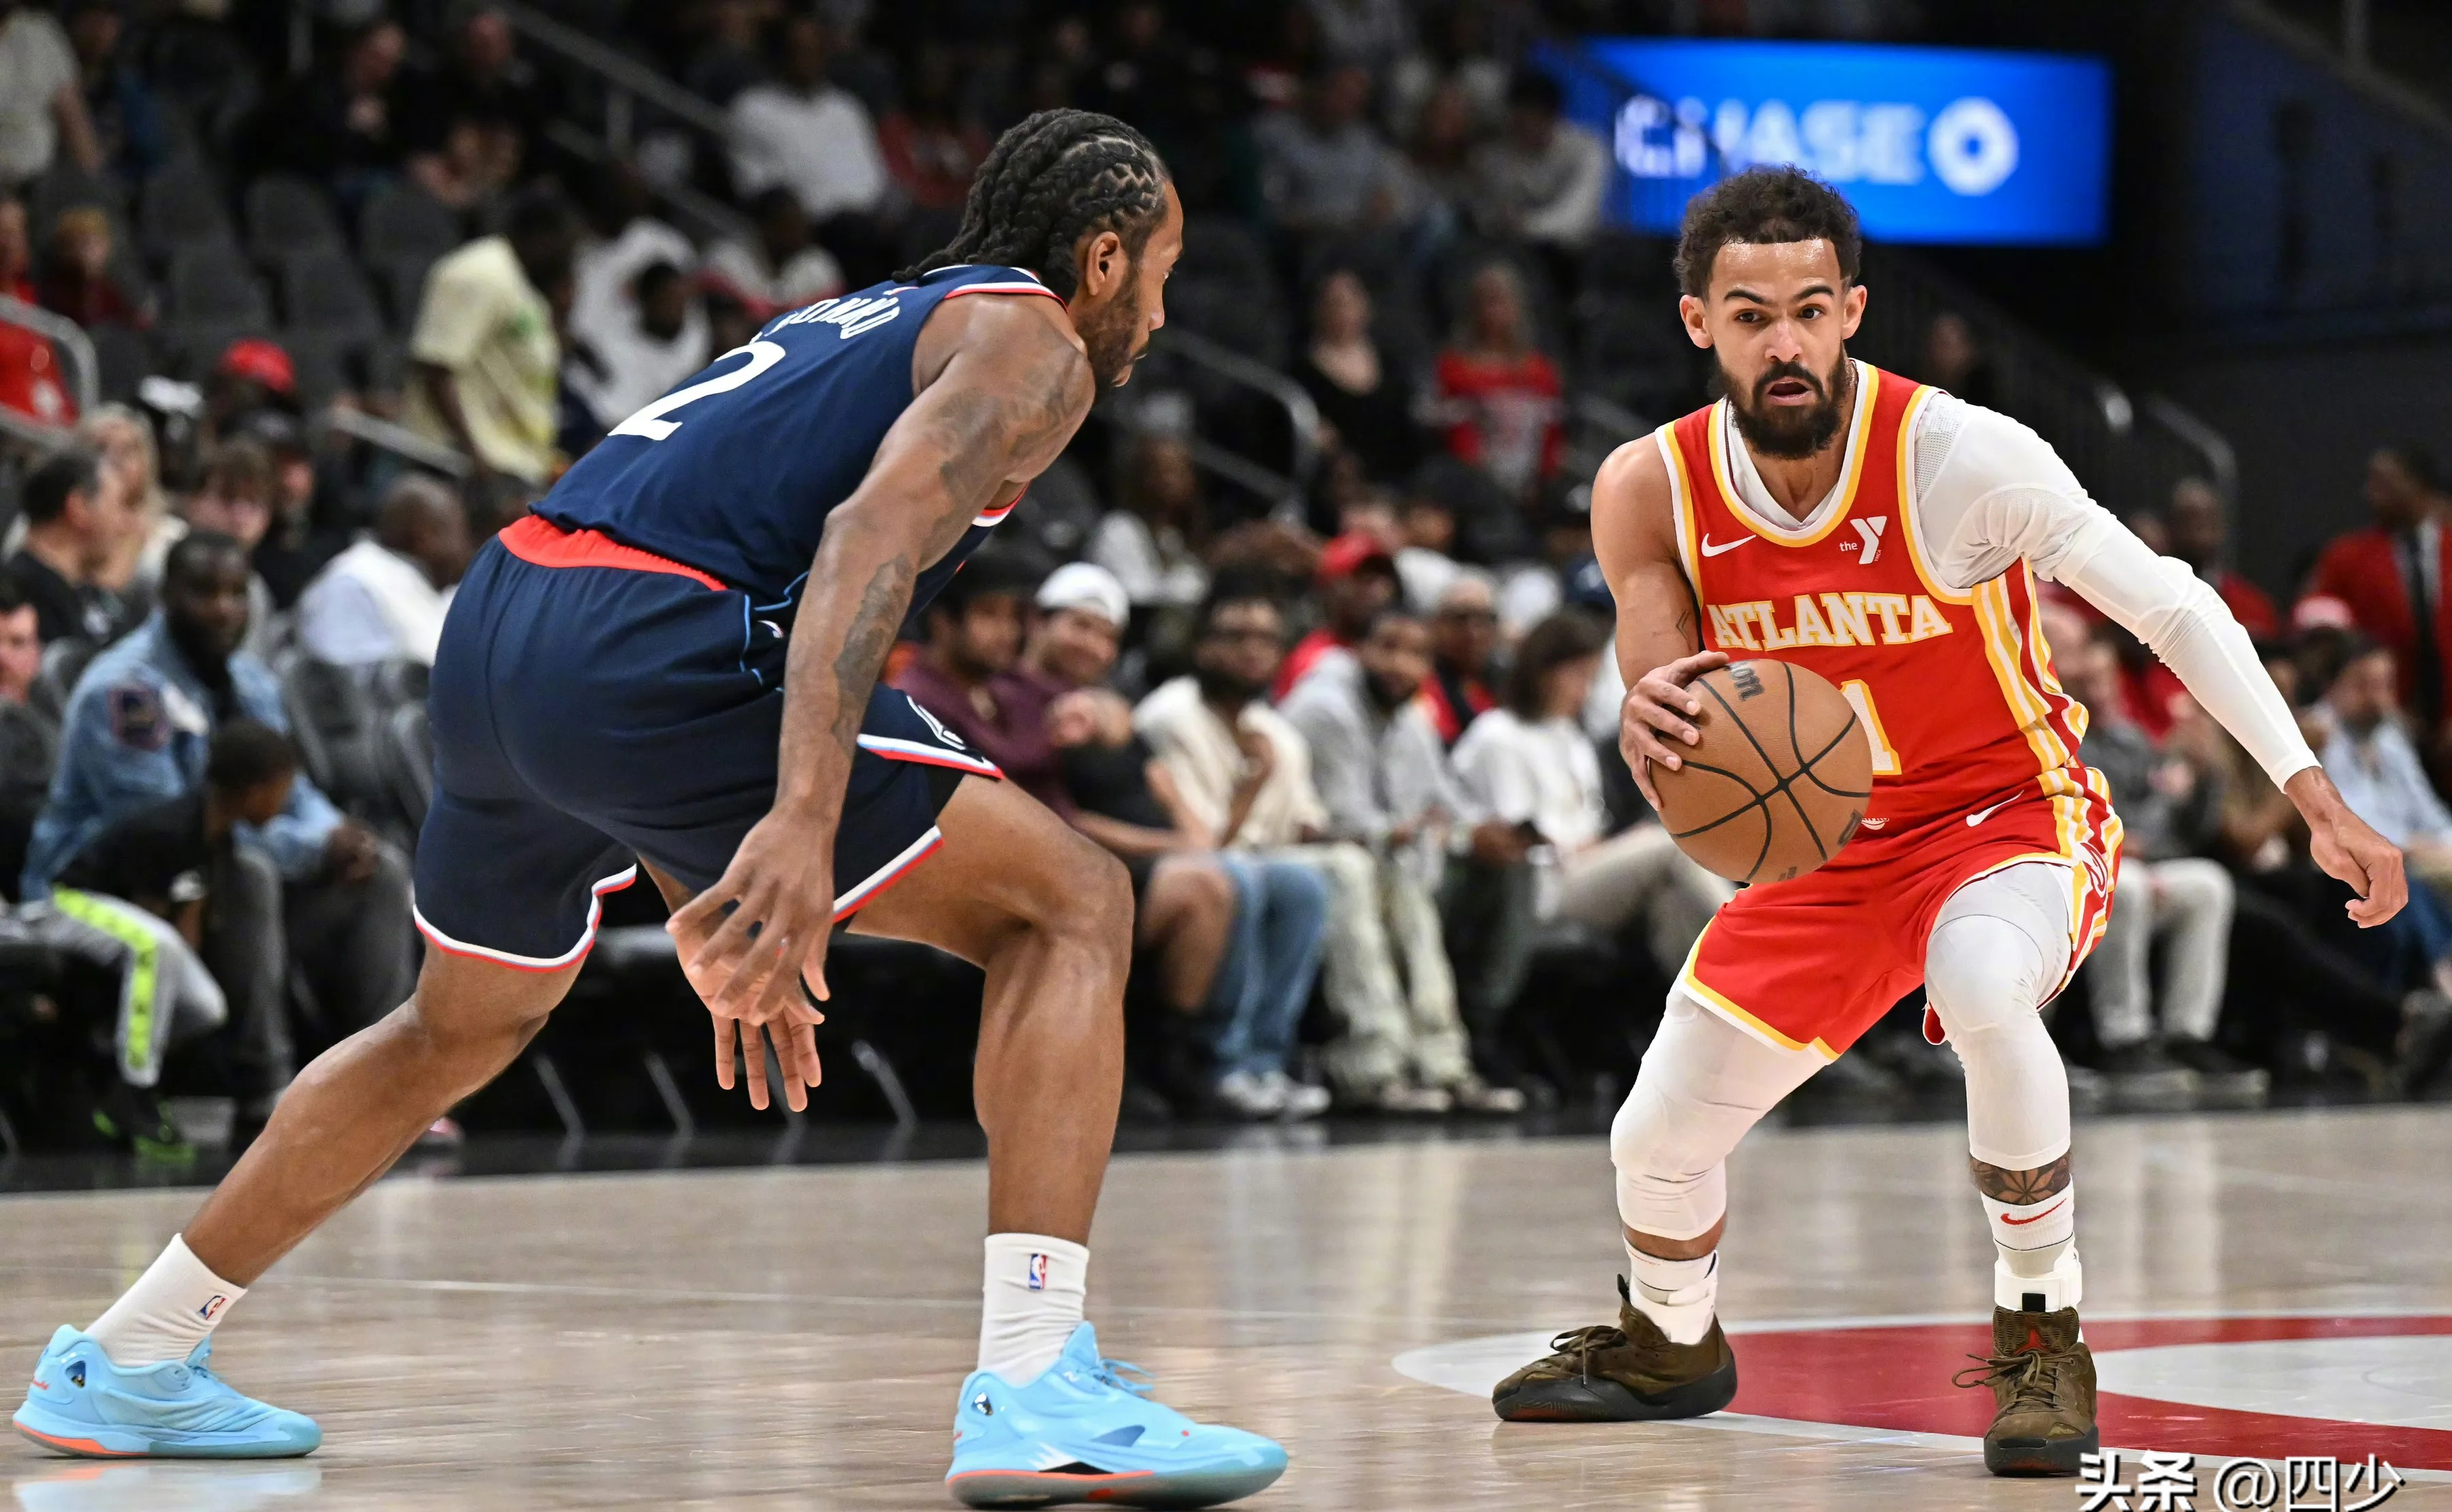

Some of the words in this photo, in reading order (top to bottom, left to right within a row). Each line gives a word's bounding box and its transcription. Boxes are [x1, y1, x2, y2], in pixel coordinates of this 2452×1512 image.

[1615, 95, 1926, 185] CHASE
[607, 341, 786, 441] 2
[1839, 541, 1858, 552] the
[1706, 591, 1953, 652] ATLANTA
